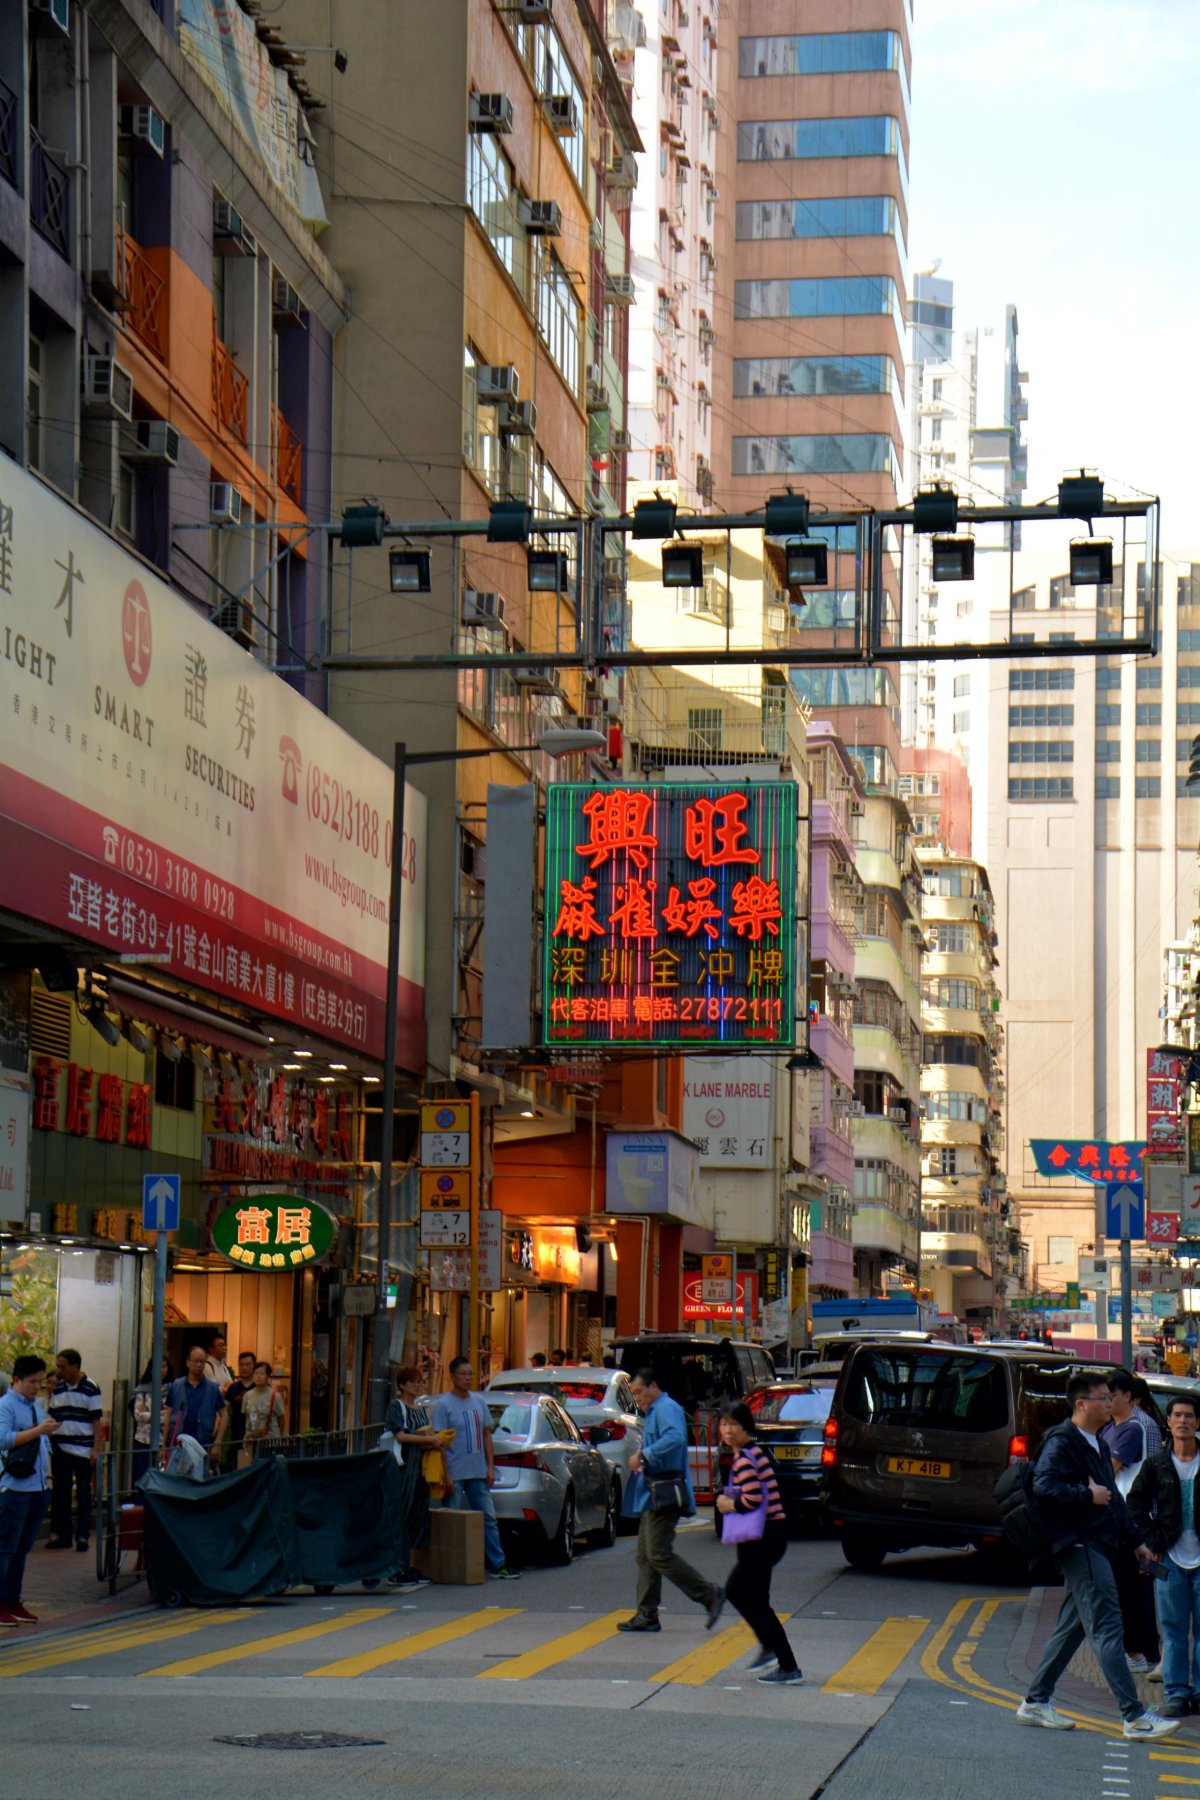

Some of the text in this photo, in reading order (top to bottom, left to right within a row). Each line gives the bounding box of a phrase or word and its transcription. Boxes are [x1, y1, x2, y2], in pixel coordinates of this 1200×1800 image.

[0, 626, 255, 812] IGHT SMART SECURITIES
[306, 760, 416, 885] (852)3188 028
[575, 788, 761, 869] 興旺
[305, 853, 390, 926] www.bsgroup.com.
[120, 836, 353, 978] (852) 3188 0928 www.bsgroup.com.hk
[552, 875, 783, 941] 麻雀娛樂
[301, 977, 368, 1043] (旺角第2分行)
[551, 996, 629, 1022] 代客泊車
[680, 998, 782, 1020] 27872111
[693, 1083, 722, 1099] LANE
[725, 1082, 771, 1099] MARBLE
[452, 1135, 461, 1146] 7
[452, 1152, 461, 1164] 7
[236, 1206, 312, 1244] 富居
[452, 1213, 461, 1225] 7
[453, 1232, 467, 1244] 12
[684, 1305, 712, 1313] GREEN
[785, 1448, 801, 1458] HD
[897, 1459, 942, 1476] KT 418
